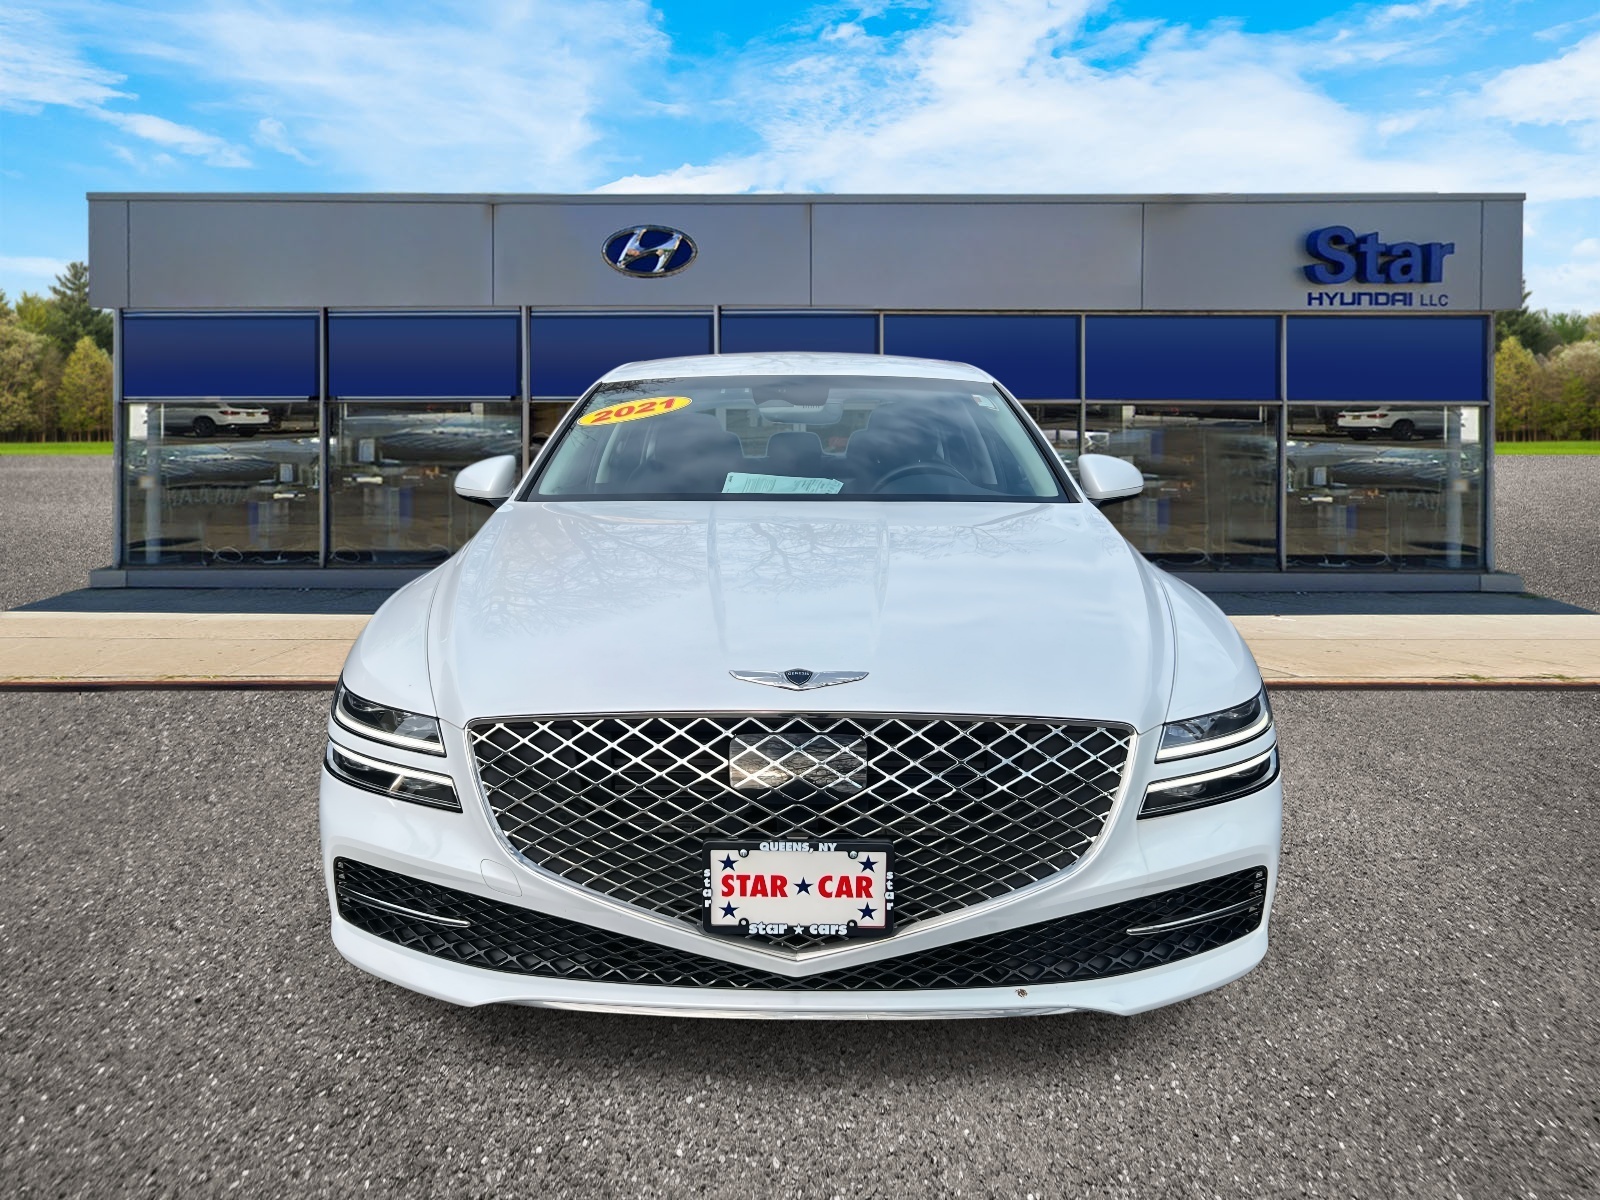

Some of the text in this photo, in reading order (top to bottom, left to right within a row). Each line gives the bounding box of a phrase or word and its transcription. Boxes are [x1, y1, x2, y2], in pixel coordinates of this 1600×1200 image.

[1304, 226, 1455, 284] Star
[1307, 292, 1449, 306] HYUNDAI LLC
[591, 397, 675, 424] 2021
[760, 842, 837, 853] QUEENS, NY
[721, 874, 873, 899] STAR CAR
[749, 922, 848, 935] star cars
